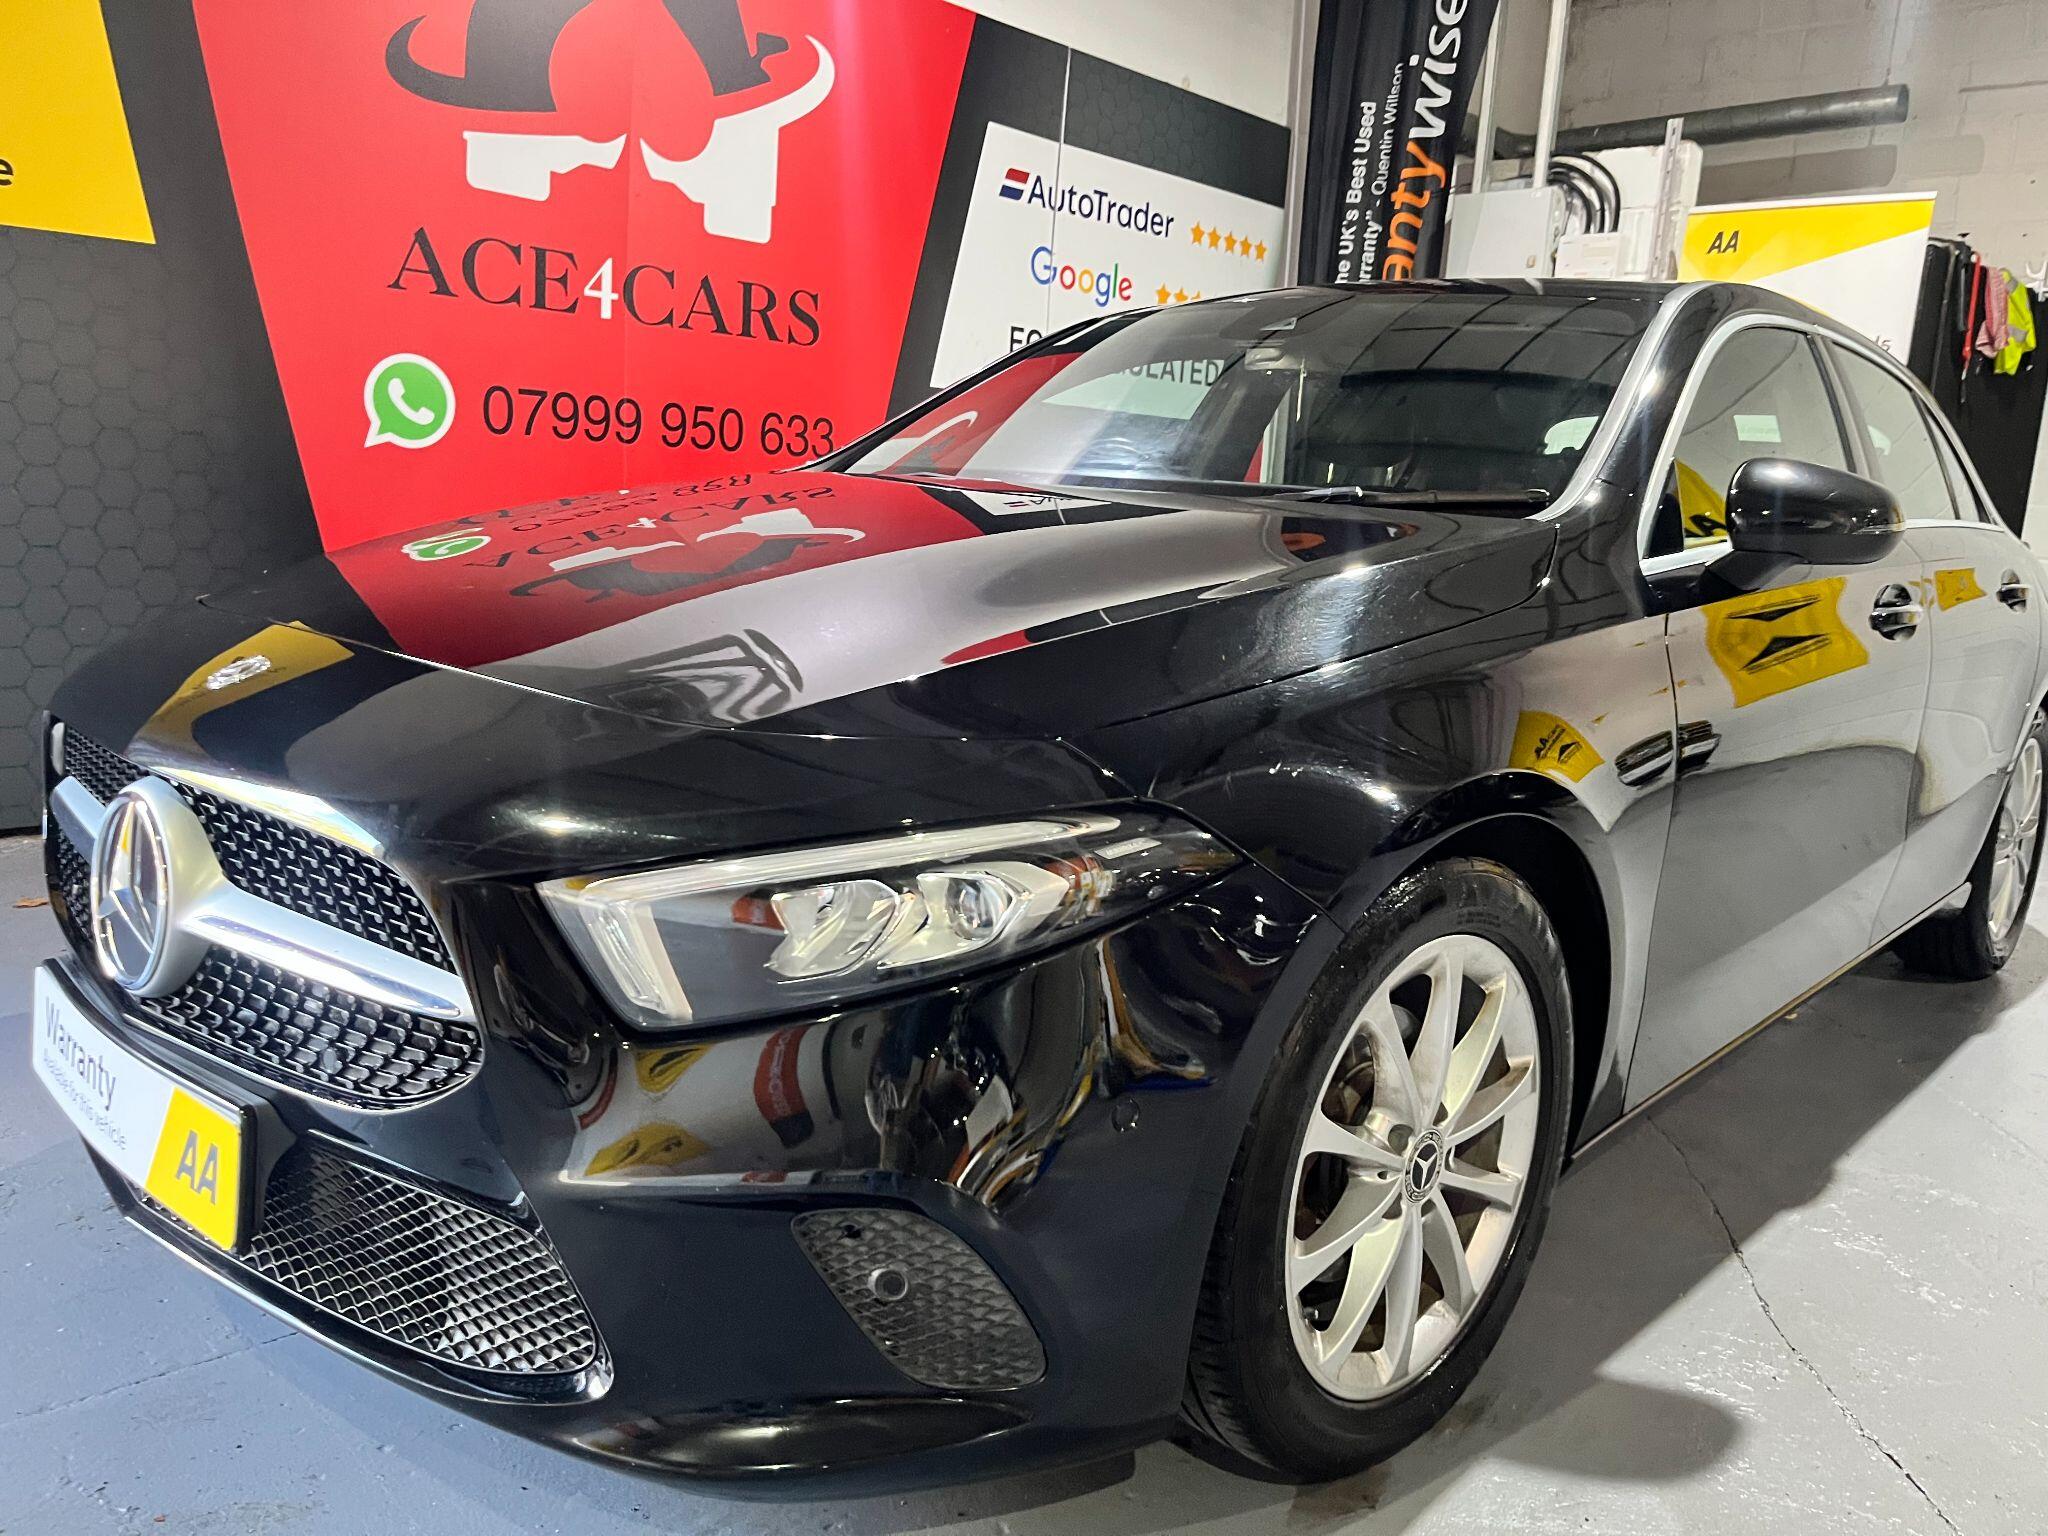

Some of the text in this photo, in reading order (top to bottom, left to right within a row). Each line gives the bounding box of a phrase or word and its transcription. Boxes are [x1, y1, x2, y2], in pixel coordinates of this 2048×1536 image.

[1353, 101, 1377, 153] Used
[1371, 129, 1394, 196] Quentin
[1383, 63, 1404, 125] Willson
[1027, 175, 1175, 238] AutoTrader
[1346, 158, 1368, 203] Best
[1338, 209, 1359, 254] UK's
[1706, 230, 1740, 255] AA
[387, 226, 820, 347] ACE4CARS
[1030, 246, 1133, 307] Google
[483, 385, 834, 457] 07999 950 633
[46, 996, 116, 1111] Warranty
[175, 1130, 218, 1205] AA
